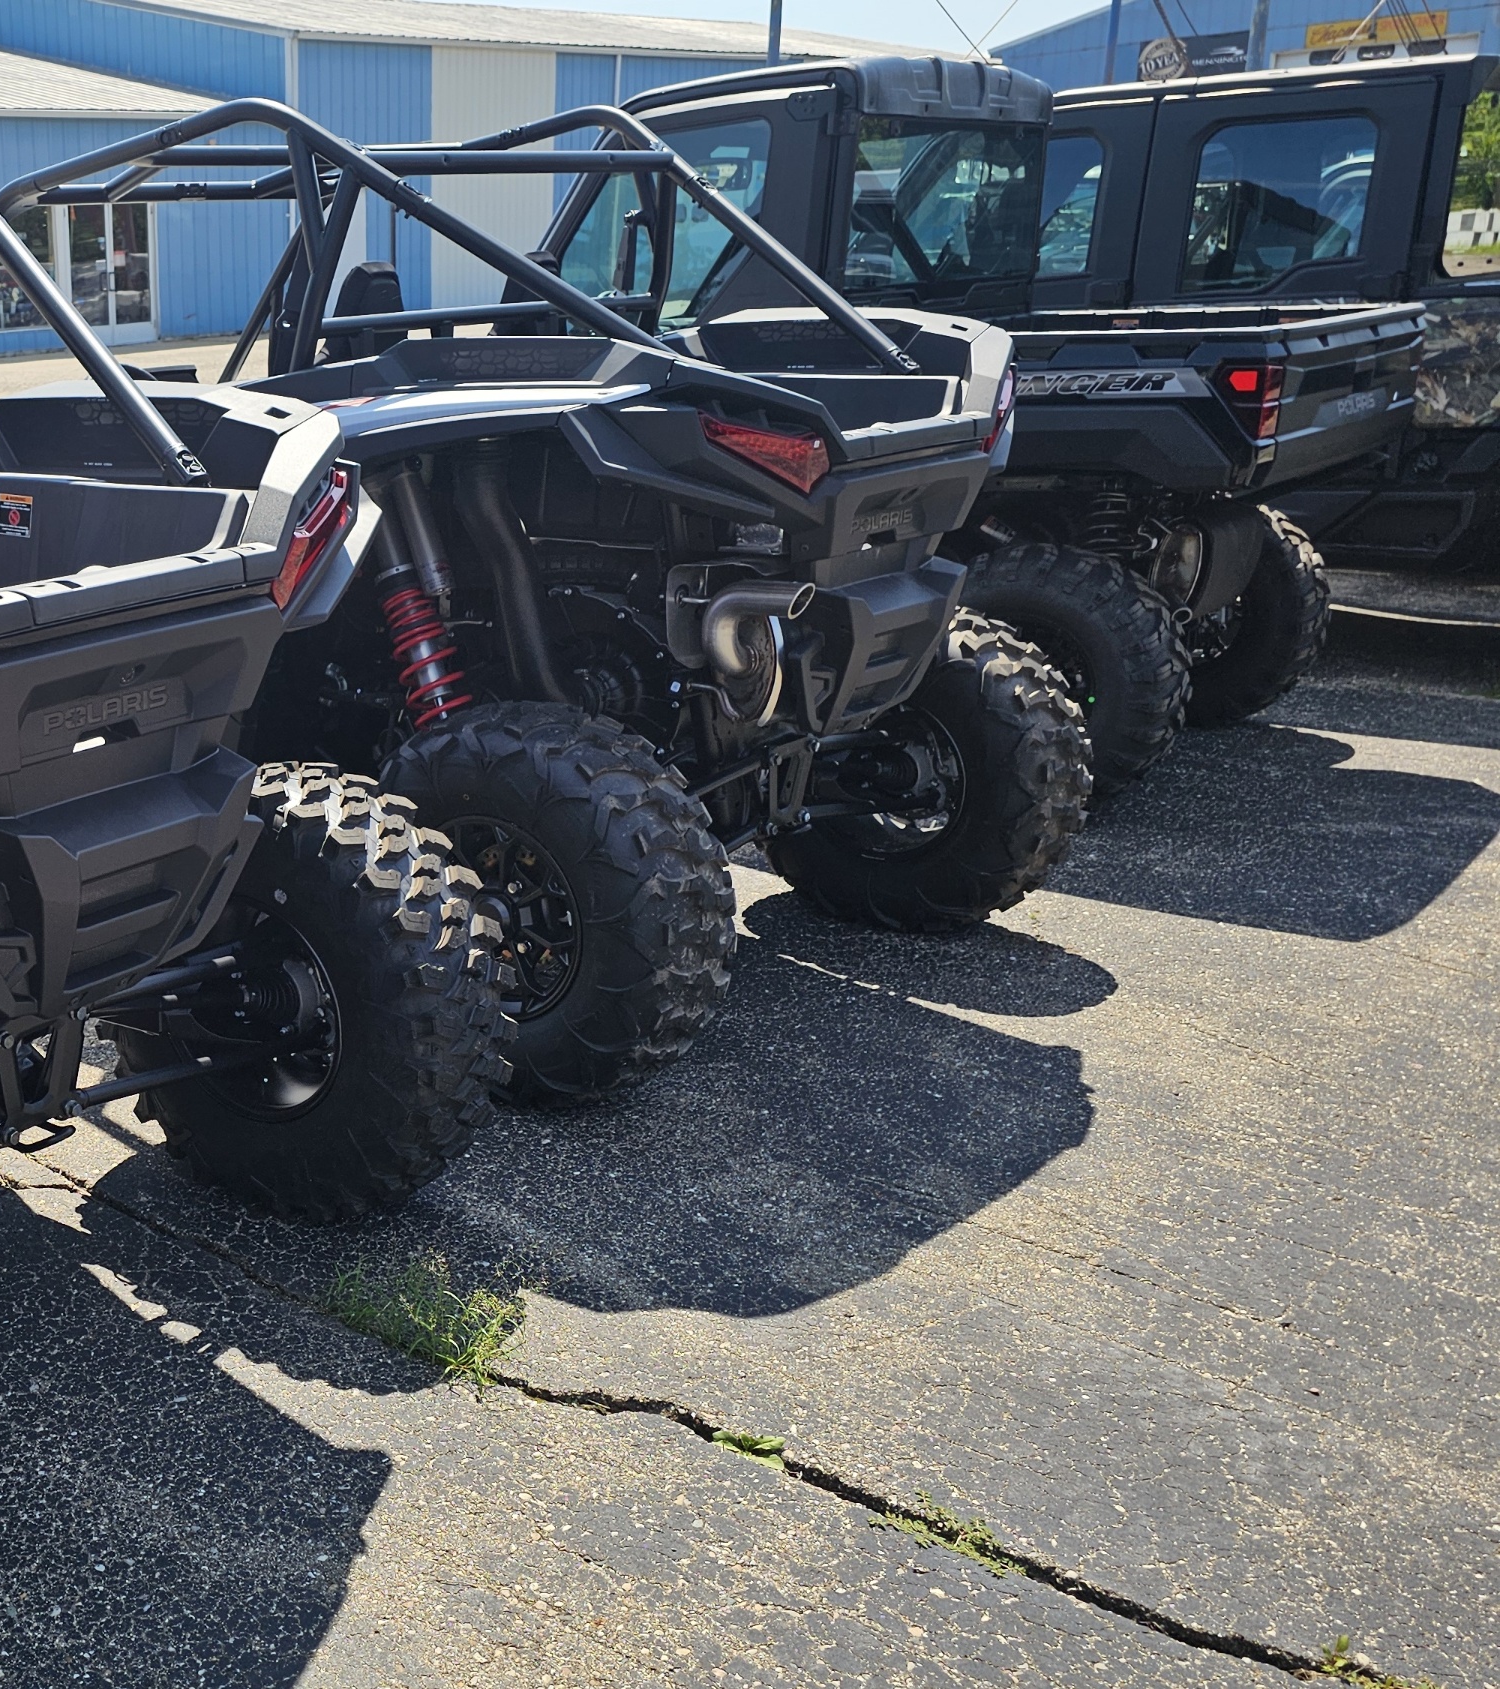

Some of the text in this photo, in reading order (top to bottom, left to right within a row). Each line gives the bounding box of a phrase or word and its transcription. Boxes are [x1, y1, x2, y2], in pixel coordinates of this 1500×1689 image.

[1141, 59, 1155, 74] 10
[1156, 51, 1180, 68] YEA
[1191, 55, 1250, 66] BENNINGTO
[1016, 370, 1178, 395] NGER
[850, 507, 914, 535] POLARIS
[44, 685, 169, 736] POLARIS
